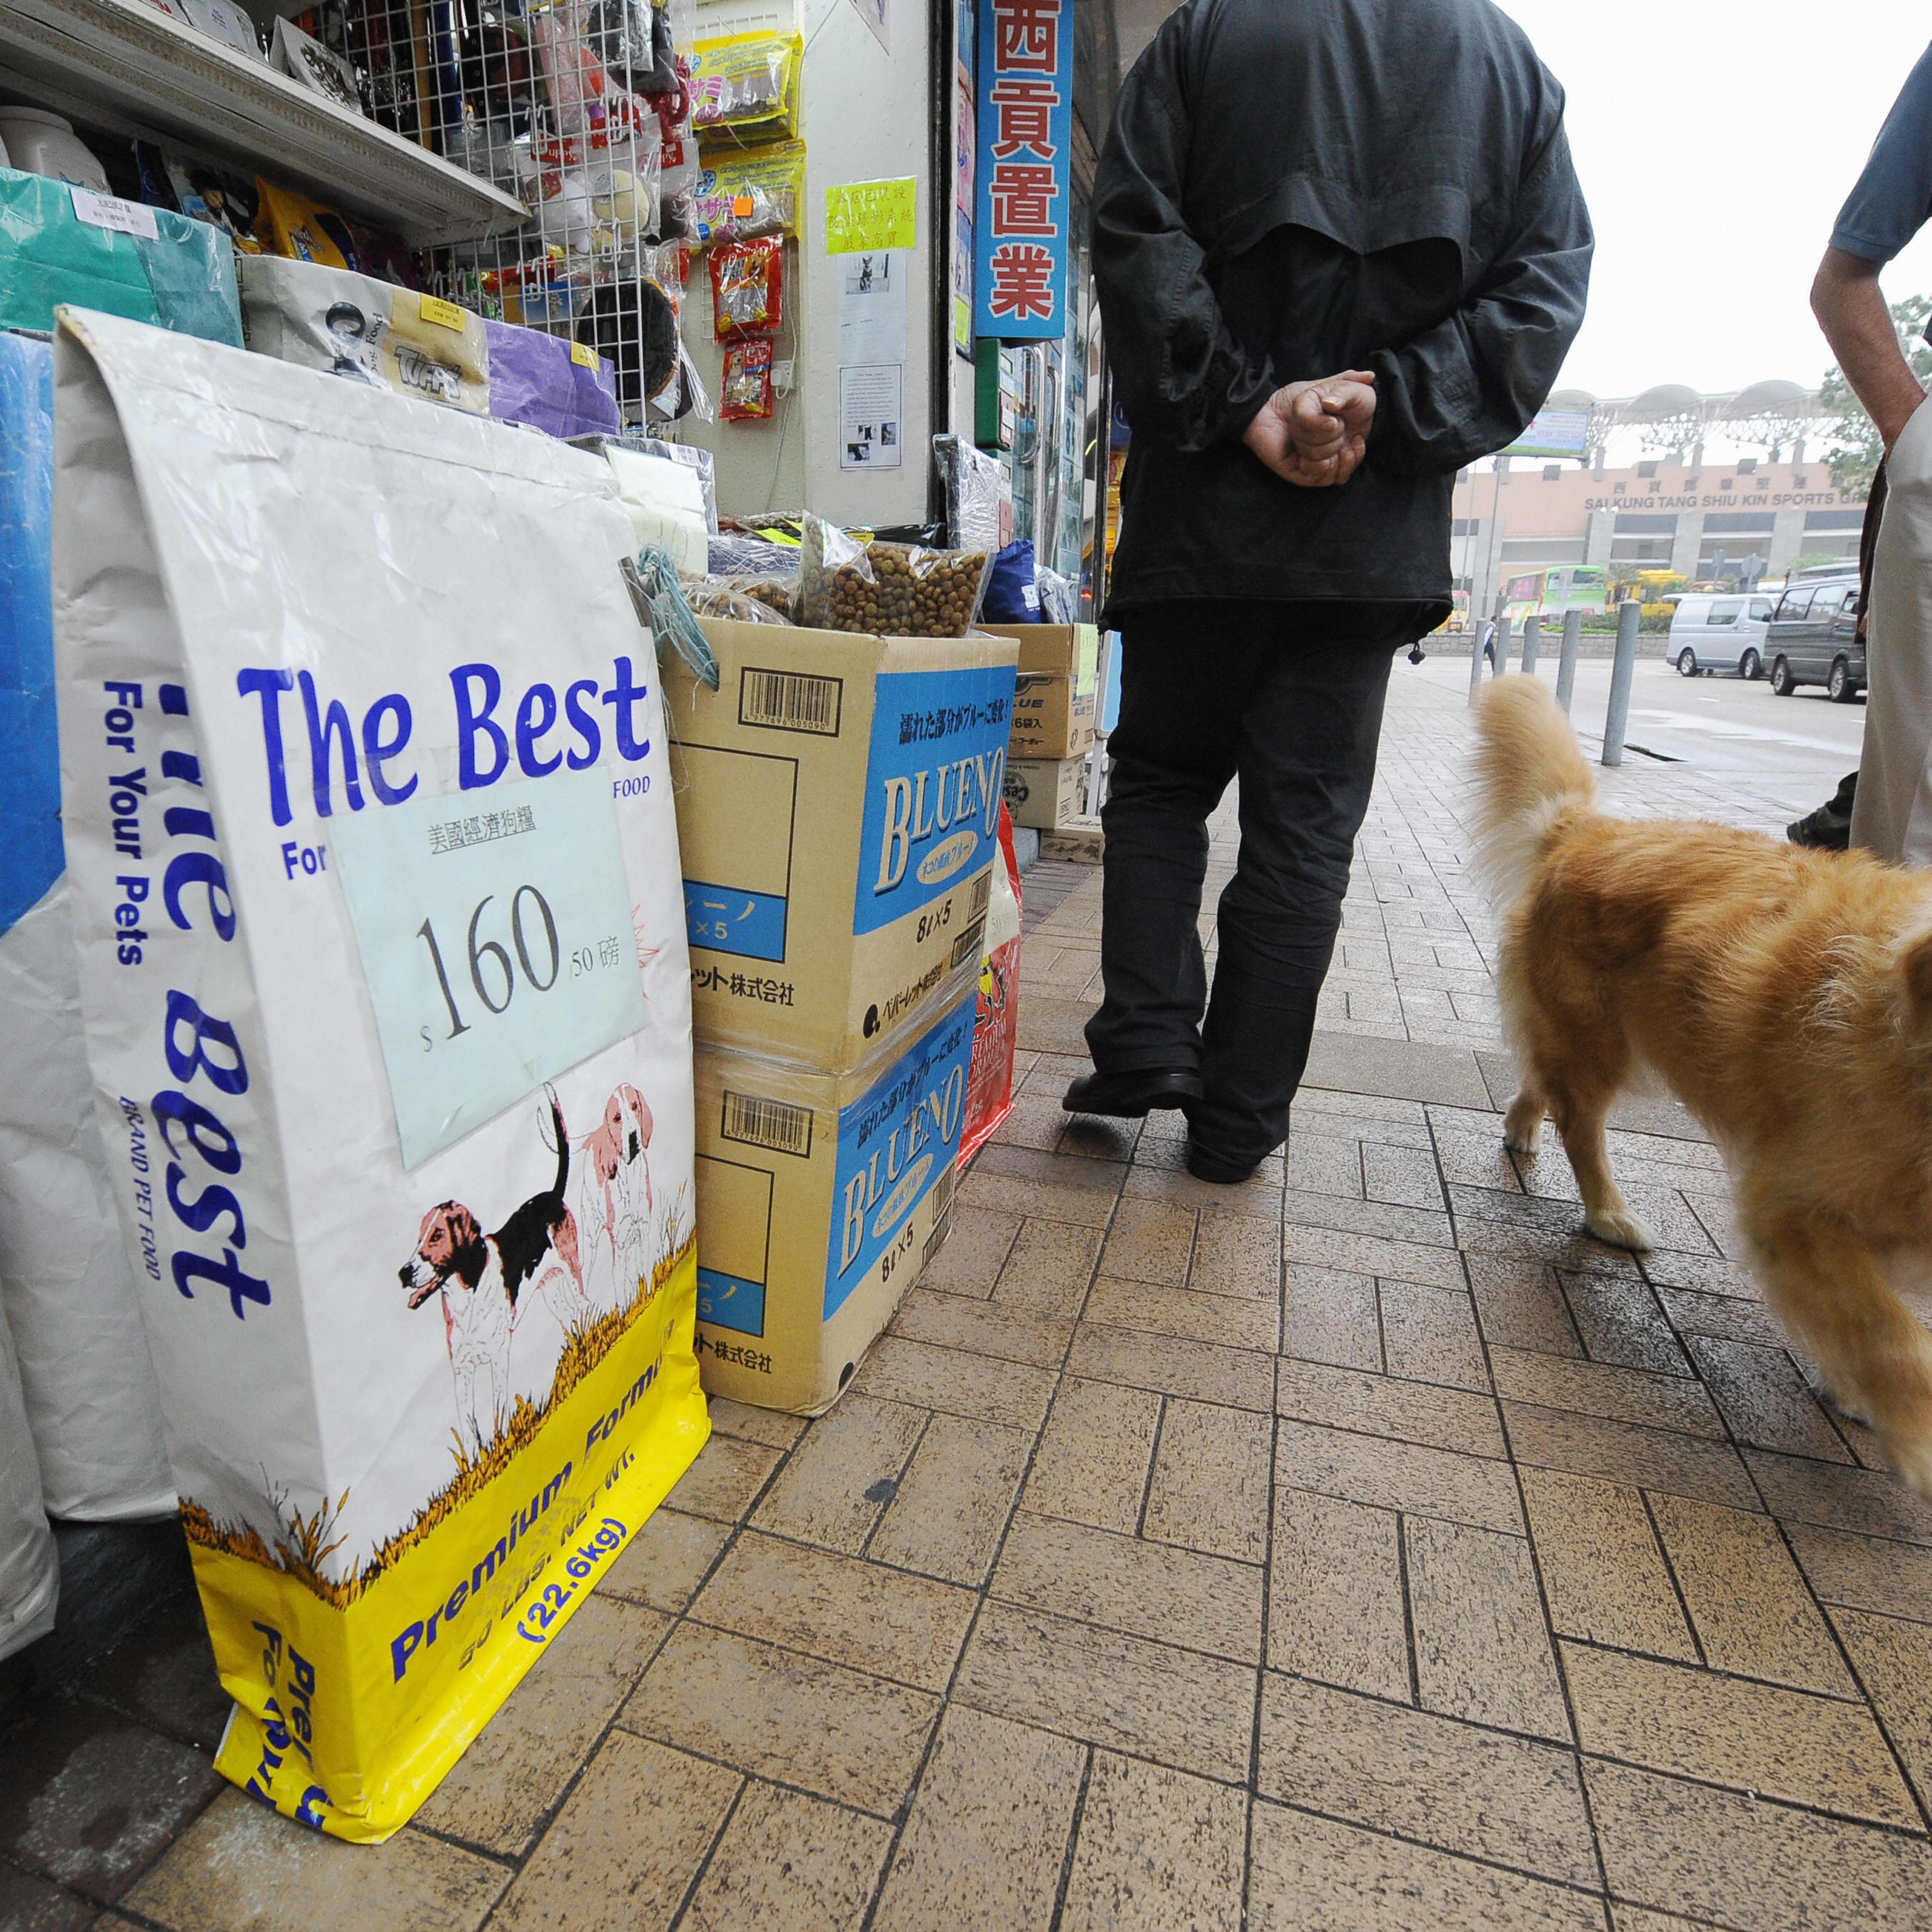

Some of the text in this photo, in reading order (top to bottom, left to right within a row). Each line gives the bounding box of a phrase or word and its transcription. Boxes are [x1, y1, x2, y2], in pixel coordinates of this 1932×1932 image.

[990, 0, 1061, 320] 西貢置業
[365, 312, 383, 345] Food
[1585, 498, 1608, 510] SAI
[1610, 497, 1654, 509] KUNG
[1657, 496, 1697, 508] TANG
[1703, 494, 1737, 507] SHIU
[1742, 494, 1767, 506] KIN
[1773, 493, 1835, 505] SPORTS
[236, 667, 418, 826] The
[449, 656, 650, 790] Best
[790, 719, 826, 731] 005090
[1012, 717, 1043, 729] 6袋入
[613, 775, 651, 799] FOOD
[103, 680, 149, 966] For Your Pets
[427, 806, 537, 853] 美國經濟狗糧
[873, 747, 1004, 893] BLUENO
[281, 841, 327, 880] For
[598, 936, 619, 968] 磅
[691, 965, 795, 1007] ット株式会社
[971, 1017, 1006, 1064] REMIUM
[150, 989, 272, 1321] Best
[767, 1139, 798, 1152] 005090
[119, 1096, 162, 1281] BRAND PET FOOD
[838, 1065, 963, 1278] BLUENO
[390, 1318, 675, 1684] Premium Formu
[517, 1517, 628, 1644] (22.6kg)
